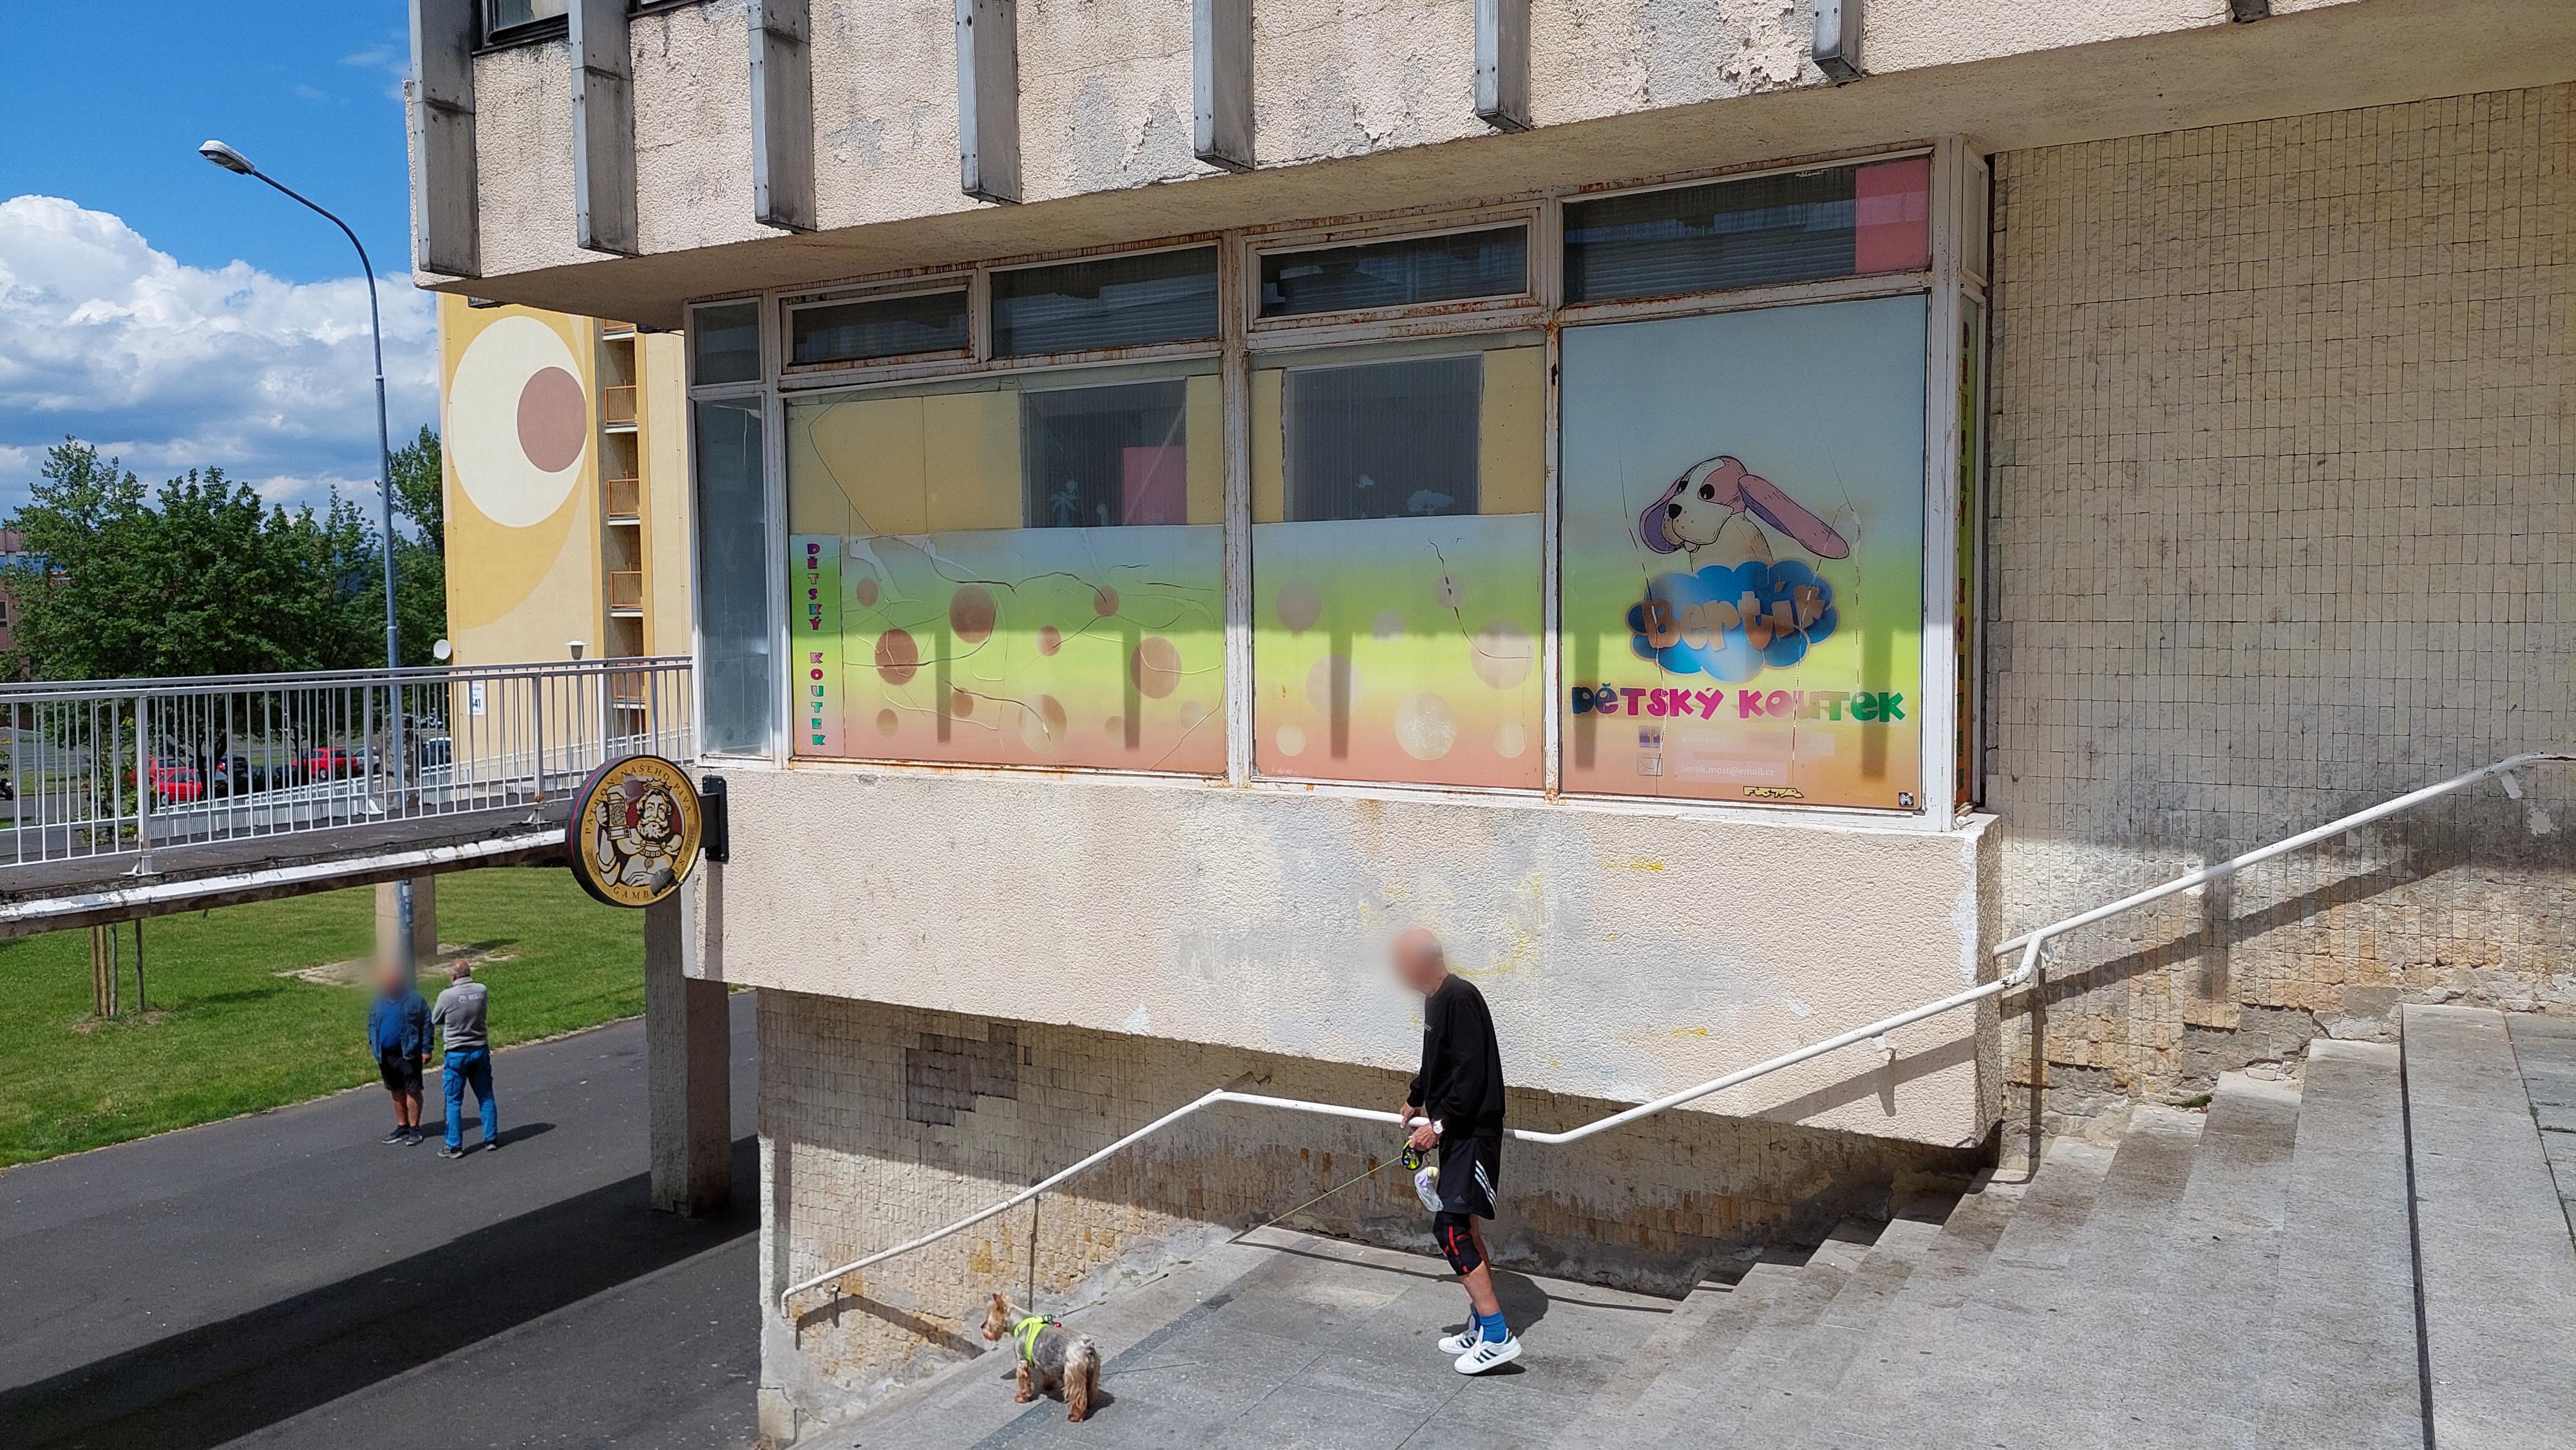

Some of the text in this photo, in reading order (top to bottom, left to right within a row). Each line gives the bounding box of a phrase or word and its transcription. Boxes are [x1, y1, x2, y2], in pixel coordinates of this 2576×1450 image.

[807, 543, 826, 746] DĚTSKÝ KOUTEK
[585, 764, 692, 834] PATRON NAŠEHO PIVA
[613, 858, 685, 899] GAMBUS
